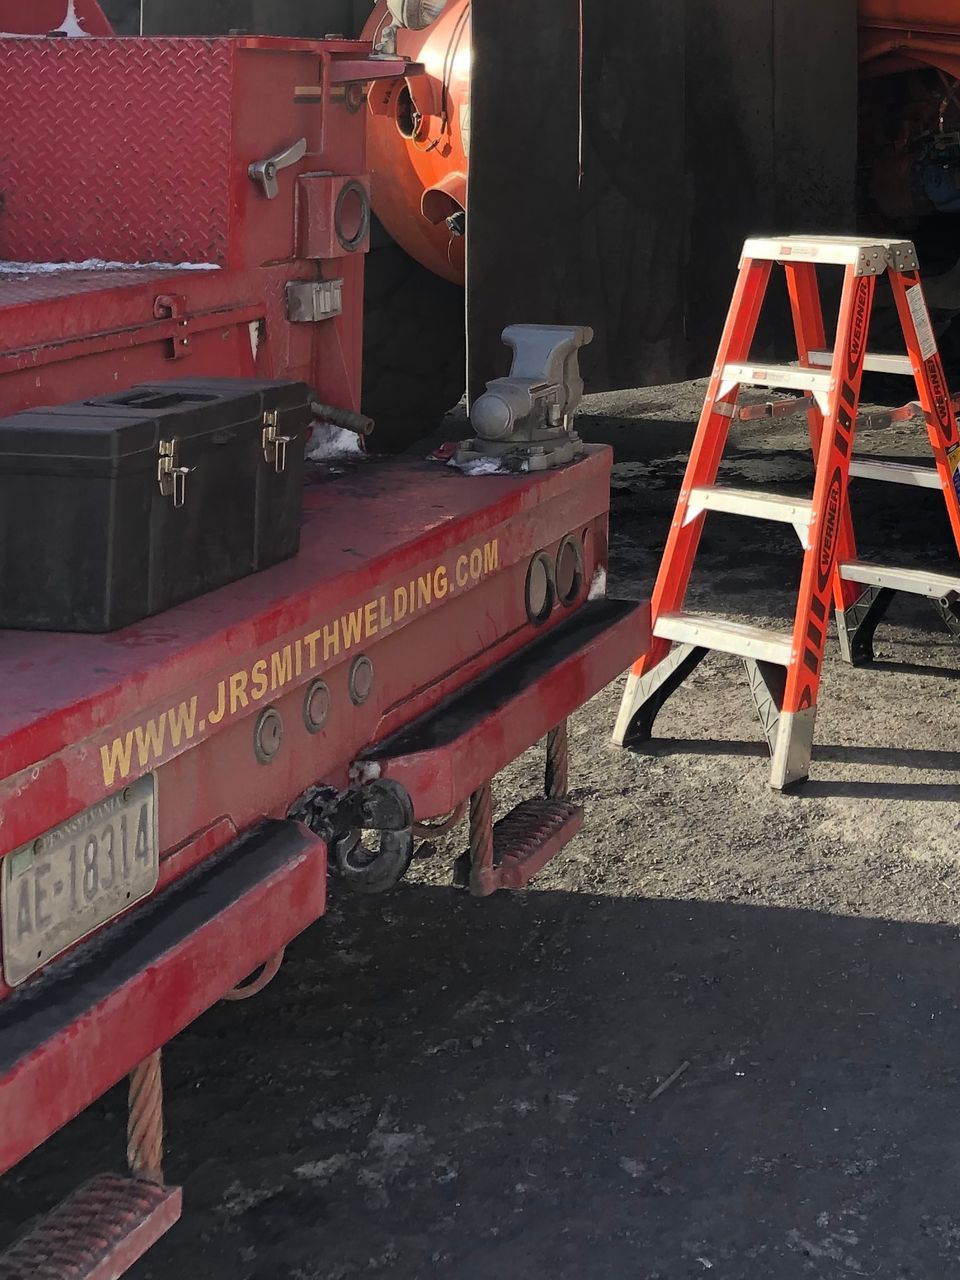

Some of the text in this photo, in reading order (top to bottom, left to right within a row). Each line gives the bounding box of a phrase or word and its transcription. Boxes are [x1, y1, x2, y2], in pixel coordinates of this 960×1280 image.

[851, 282, 868, 354] WERNER
[821, 486, 840, 566] WERNER
[99, 538, 500, 787] WWW.JRSMITHWELDING.COM
